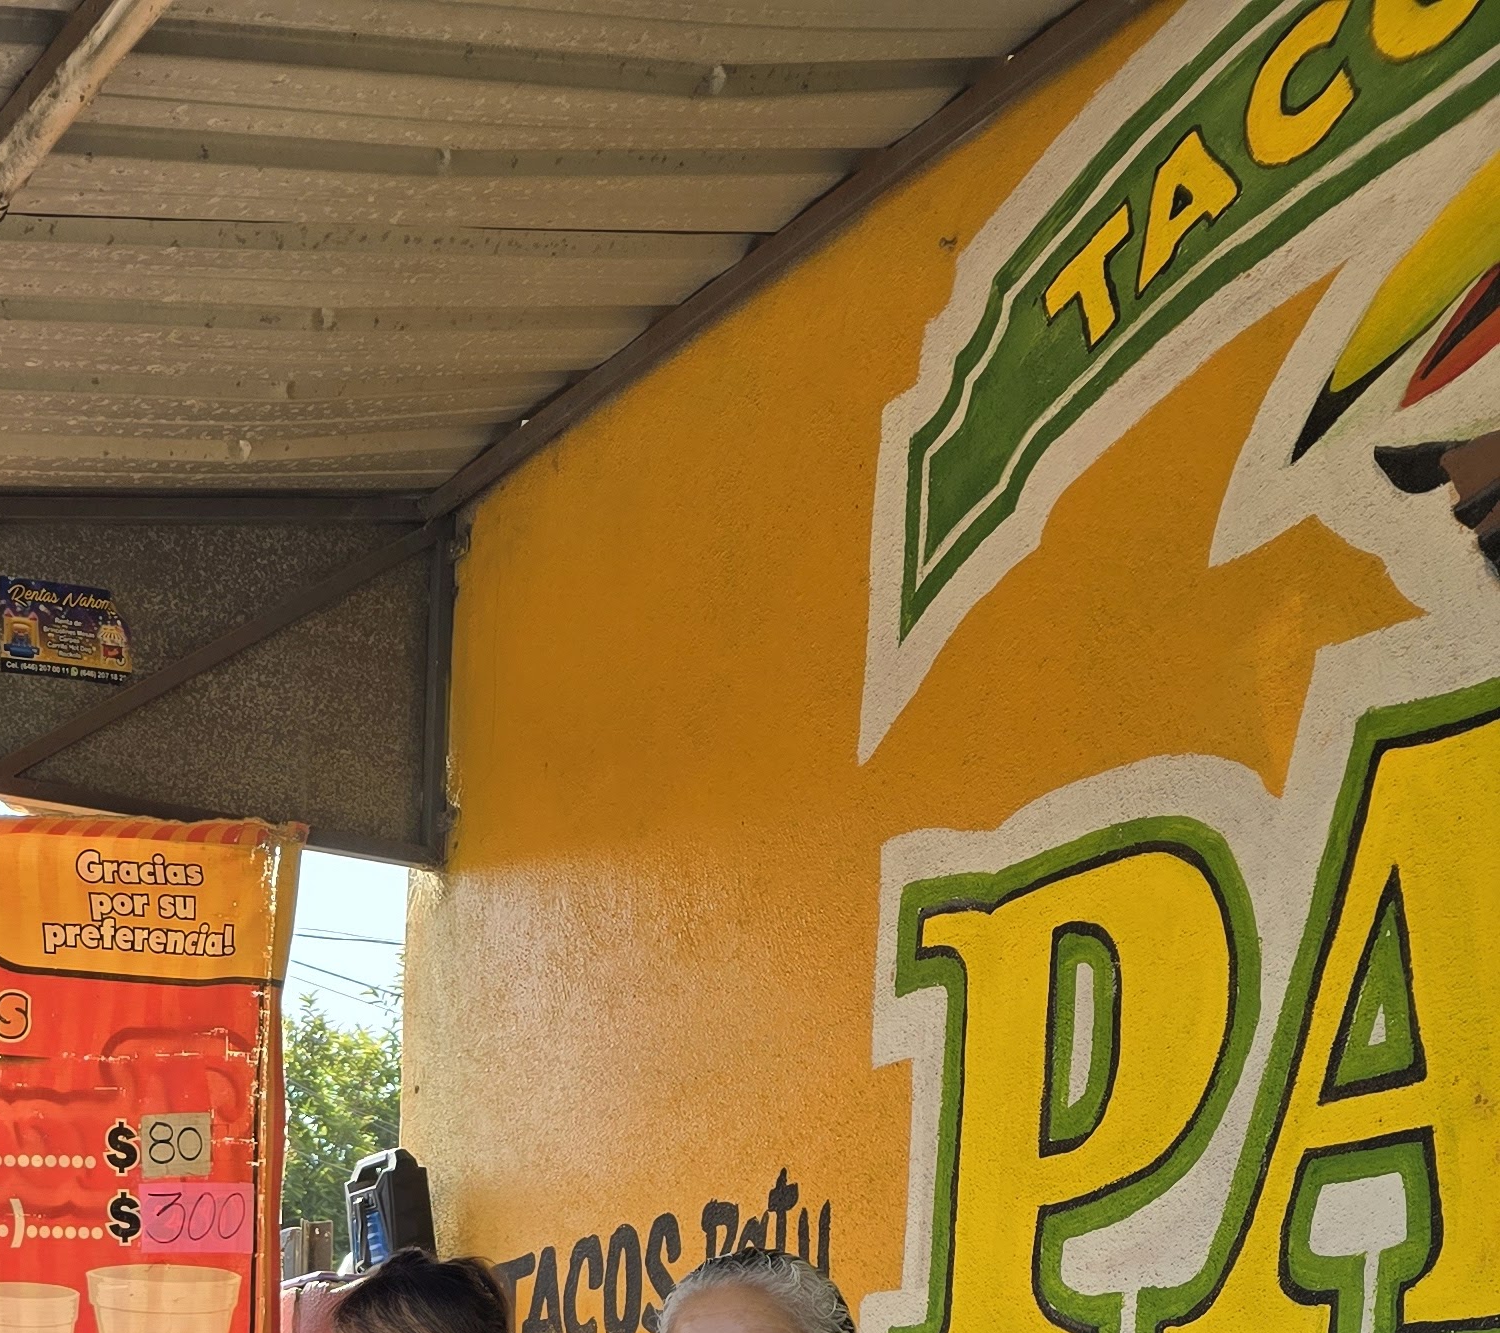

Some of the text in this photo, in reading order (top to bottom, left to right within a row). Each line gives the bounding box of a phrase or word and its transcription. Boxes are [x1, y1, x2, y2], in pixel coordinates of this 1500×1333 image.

[7, 584, 116, 614] Rentas Nahom
[75, 848, 204, 888] Gracias
[88, 889, 196, 924] por su
[42, 920, 236, 958] preferencia!
